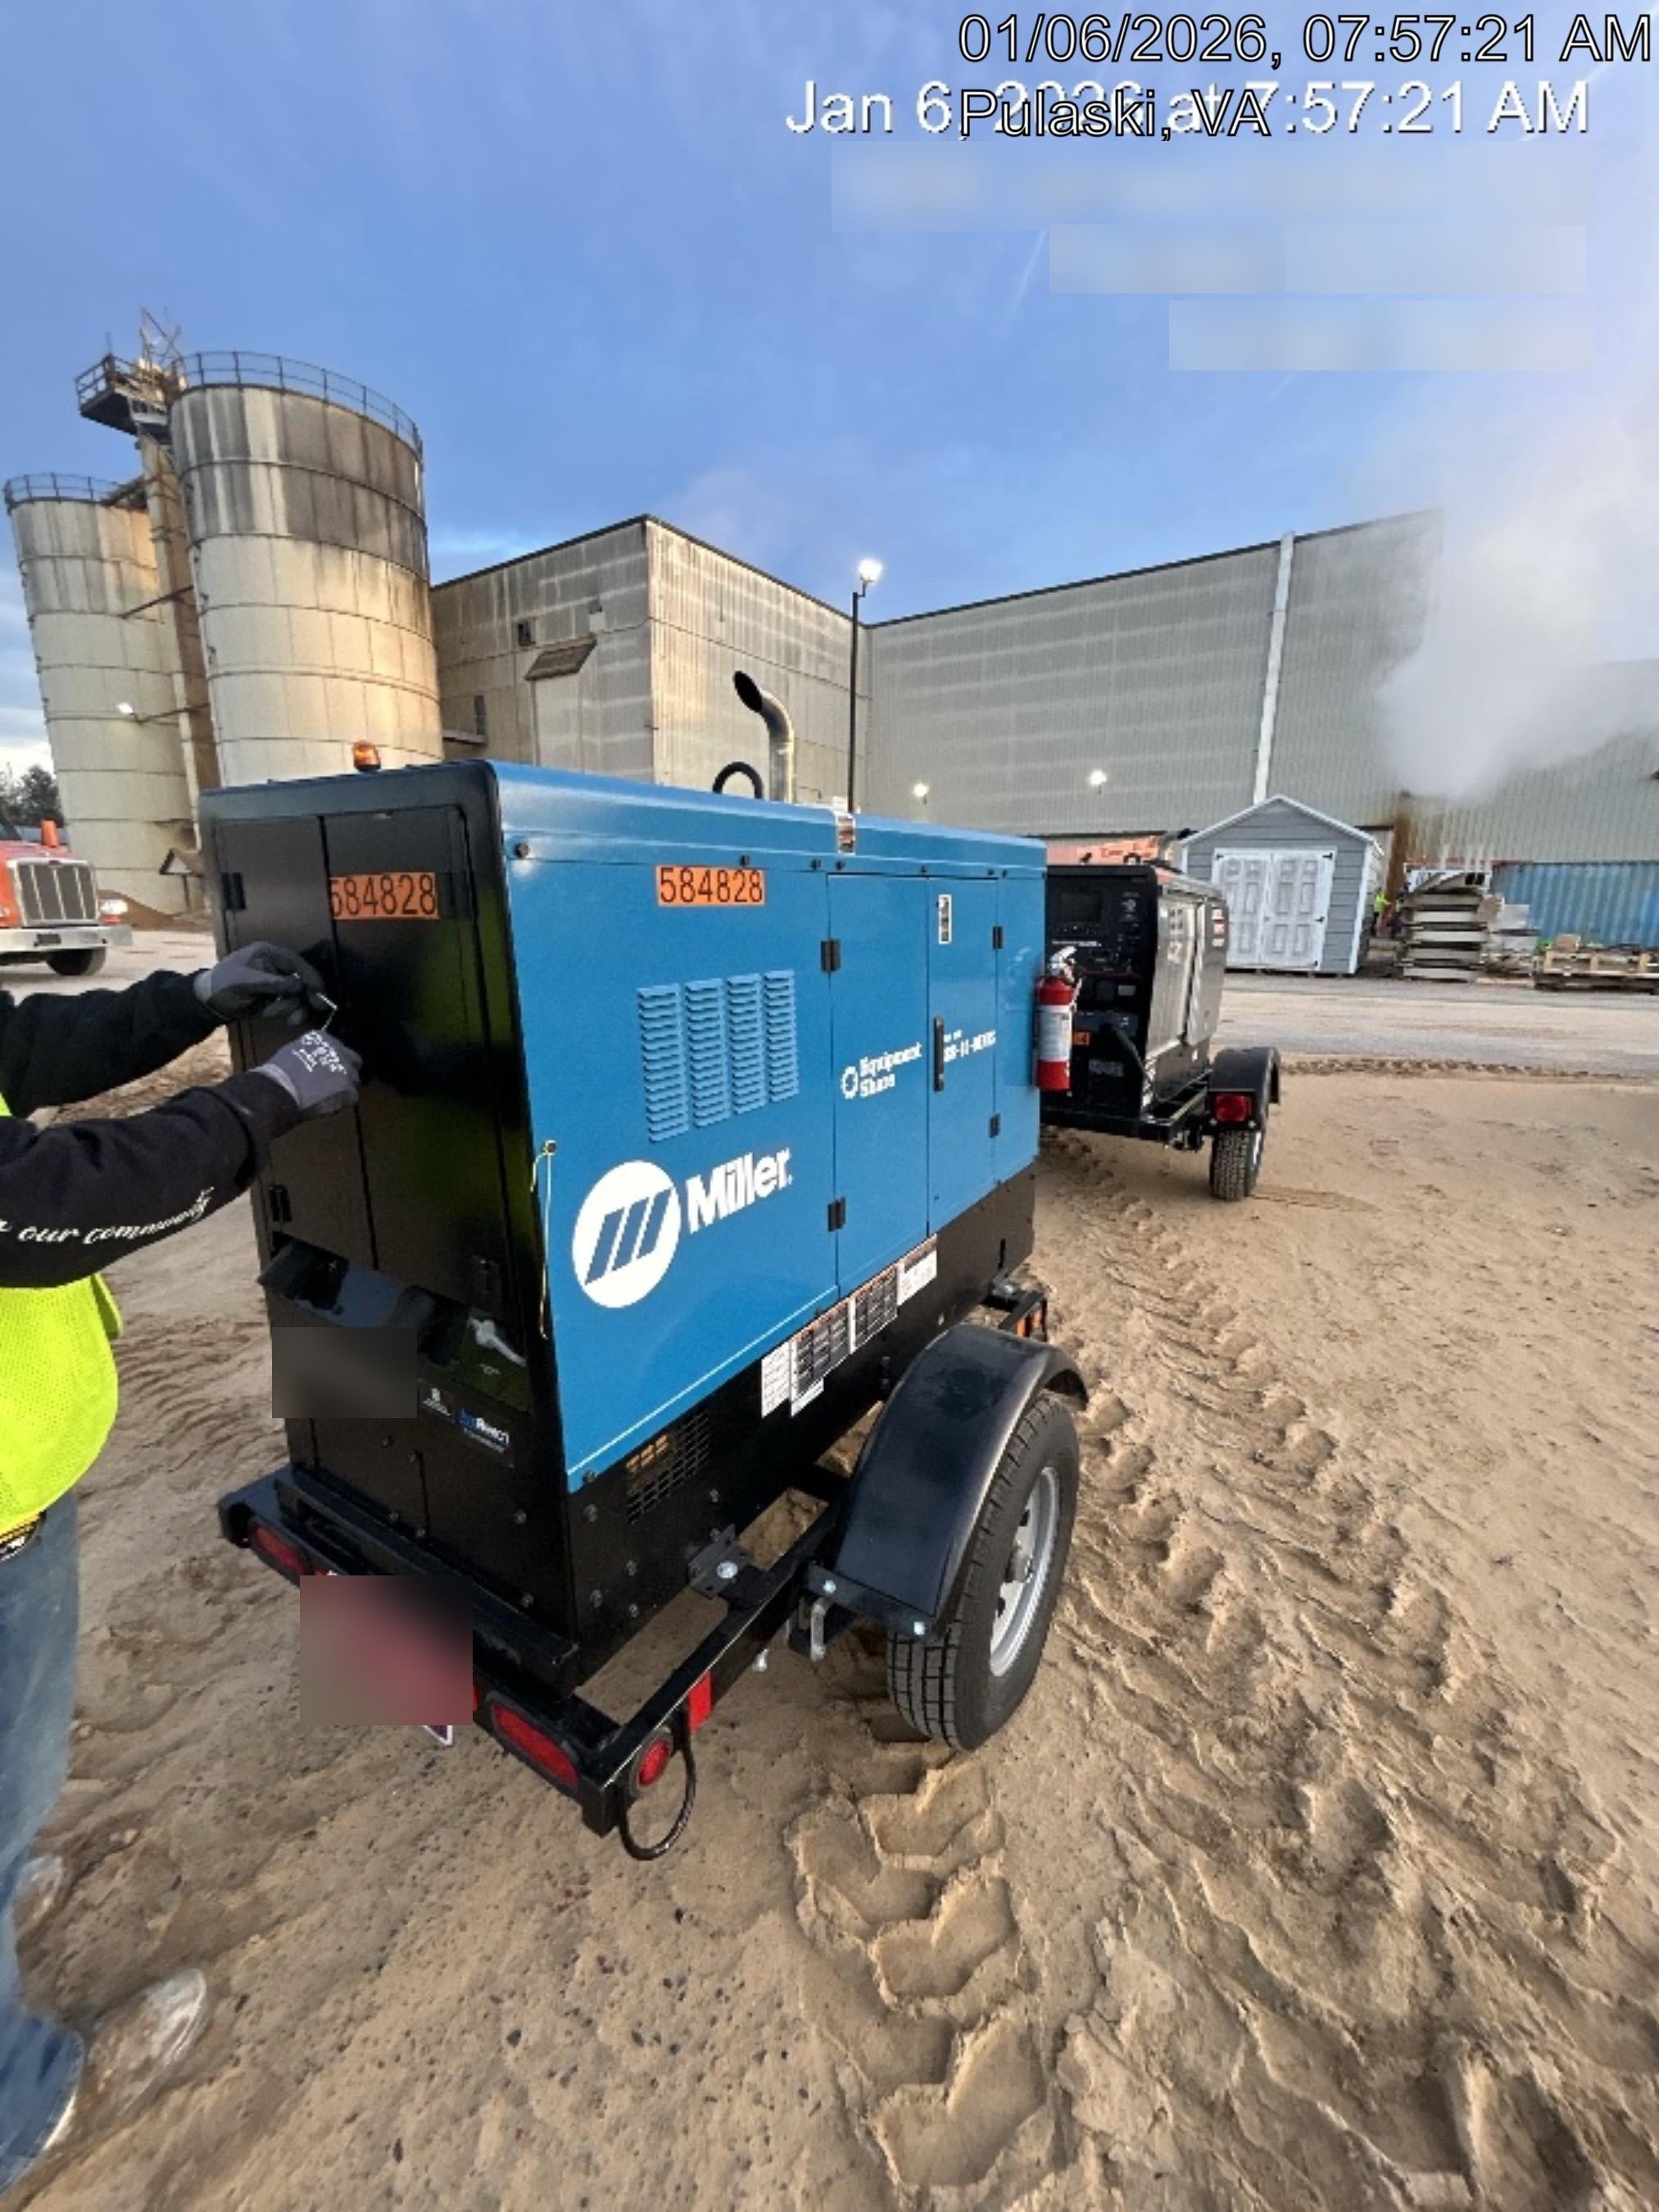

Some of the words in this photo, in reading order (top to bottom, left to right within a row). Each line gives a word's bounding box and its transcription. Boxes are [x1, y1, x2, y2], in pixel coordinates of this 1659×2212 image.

[329, 873, 437, 917] 584828
[659, 867, 764, 904] 584828
[685, 1148, 791, 1235] Miller
[17, 1226, 80, 1243] our
